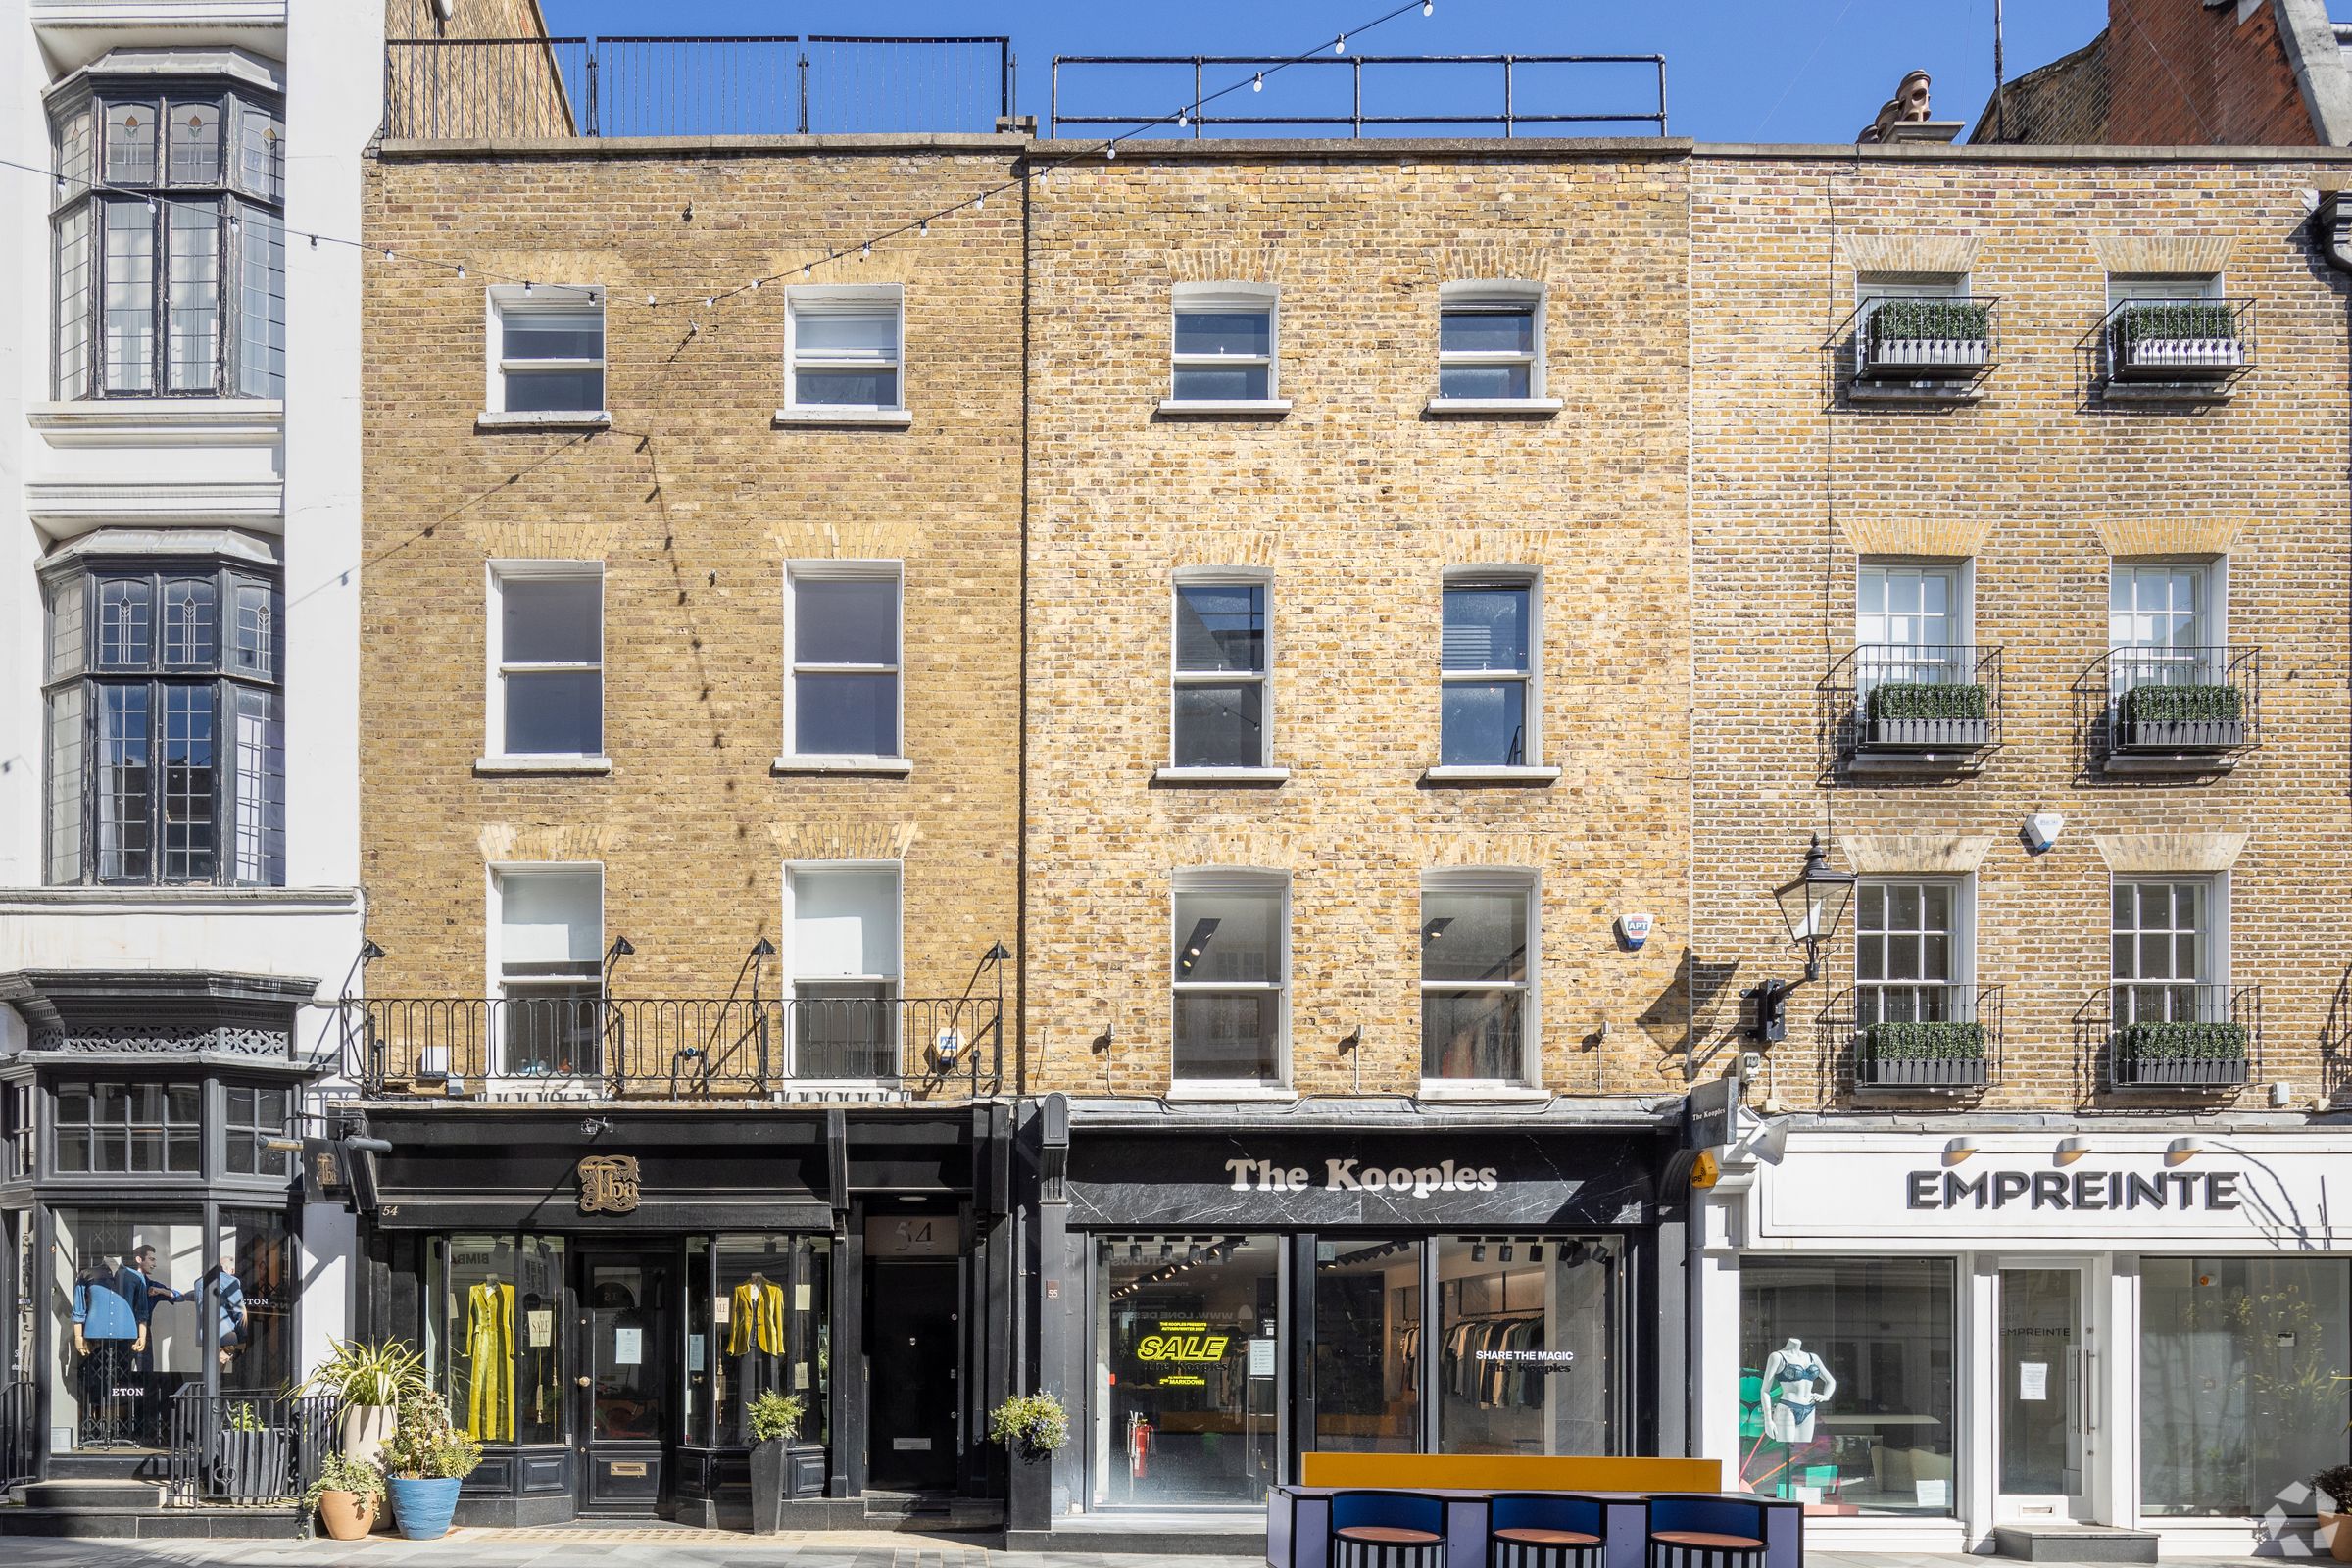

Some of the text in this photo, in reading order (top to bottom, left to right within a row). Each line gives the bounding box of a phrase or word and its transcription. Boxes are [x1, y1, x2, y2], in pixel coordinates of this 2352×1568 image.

[1693, 1108, 1726, 1122] The Kooples
[1225, 1158, 1498, 1199] The Kooples
[1906, 1170, 2241, 1210] EMPREINTE
[382, 1205, 399, 1216] 54
[894, 1221, 935, 1251] 54
[1048, 1289, 1058, 1298] 55
[1999, 1327, 2071, 1337] EMPREINTE
[1137, 1335, 1229, 1361] SALE
[1475, 1350, 1574, 1361] SHARE THE MAGIC
[1485, 1362, 1572, 1375] The Kooples
[111, 1388, 144, 1396] ETON
